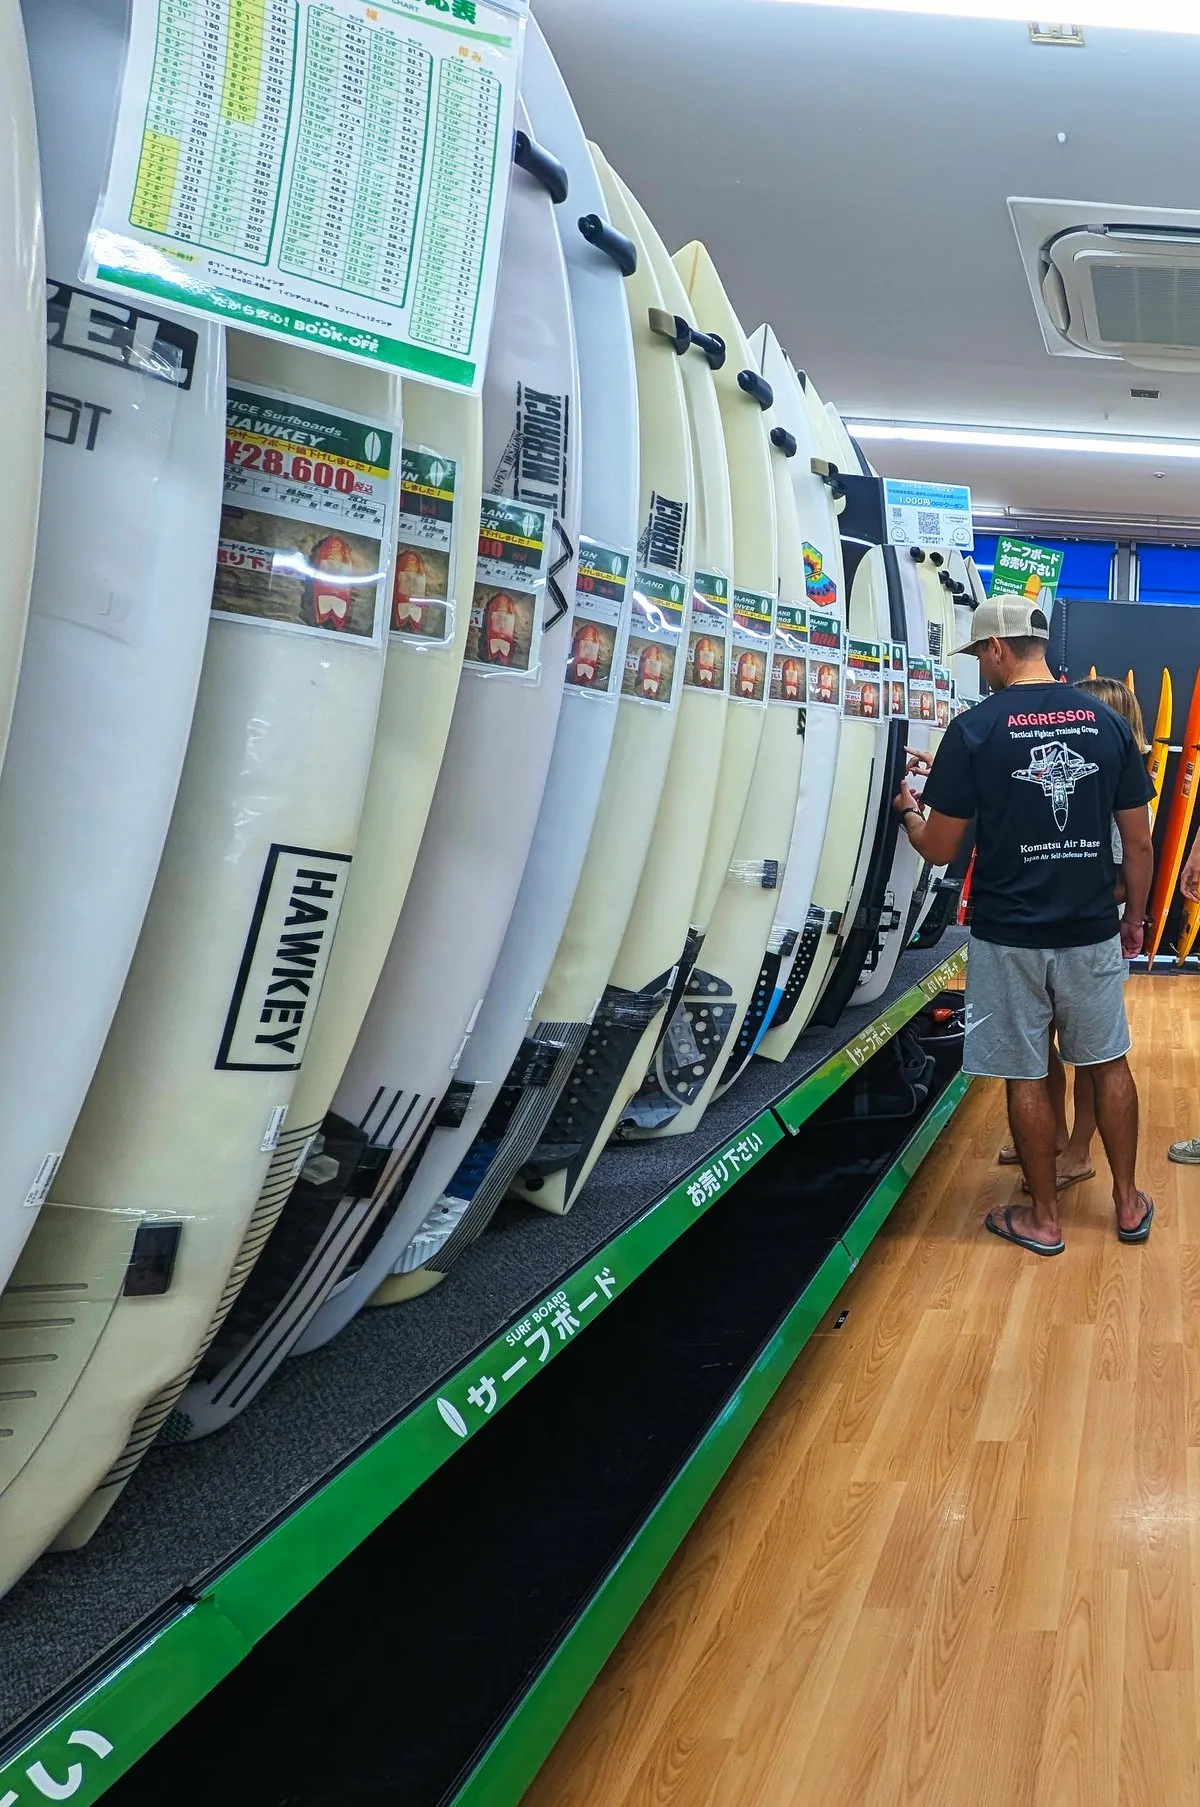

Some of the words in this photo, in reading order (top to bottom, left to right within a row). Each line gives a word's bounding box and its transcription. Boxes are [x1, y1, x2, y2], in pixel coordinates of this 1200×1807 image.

[206, 1, 221, 9] 175
[272, 5, 287, 14] 241
[205, 10, 220, 20] 178
[272, 15, 287, 24] 244
[204, 21, 220, 30] 180
[270, 36, 286, 45] 249
[202, 42, 218, 51] 185
[270, 46, 284, 55] 251
[201, 52, 217, 61] 188
[269, 56, 284, 65] 254
[201, 62, 215, 71] 191
[268, 66, 283, 75] 257
[196, 100, 211, 109] 201
[265, 96, 281, 105] 264
[194, 109, 210, 118] 203
[264, 105, 280, 114] 267
[191, 128, 207, 137] 208
[262, 124, 277, 132] 272
[189, 137, 205, 146] 211
[261, 133, 276, 142] 274
[259, 142, 274, 151] 277
[188, 147, 204, 156] 213
[258, 151, 273, 160] 279
[187, 156, 203, 165] 216
[185, 166, 202, 175] 218
[184, 175, 200, 184] 221
[254, 179, 269, 187] 287
[182, 185, 199, 193] 224
[252, 188, 268, 196] 290
[251, 197, 266, 205] 292
[179, 203, 195, 211] 229
[178, 212, 193, 220] 231
[248, 215, 263, 224] 297
[176, 221, 193, 230] 234
[247, 224, 262, 233] 300
[174, 230, 191, 239] 236
[245, 233, 261, 242] 302
[262, 409, 343, 438] Surfboards
[226, 415, 325, 447] HAWKEY
[522, 386, 562, 486] MERRICK
[650, 494, 683, 570] MERRICK
[1002, 541, 1060, 565] サーフボード
[1000, 554, 1055, 577] お売り下さい
[995, 579, 1022, 590] Channel
[1007, 710, 1096, 727] AGGRESSOR
[1010, 730, 1033, 739] Tactical
[1034, 728, 1055, 739] Fighter
[1055, 727, 1081, 735] Training
[1081, 725, 1099, 735] Group
[1020, 842, 1061, 853] Komatsu
[1064, 839, 1078, 848] Air
[1080, 839, 1100, 848] Base
[1024, 855, 1039, 863] Japan
[254, 868, 338, 1054] HAWKEY
[854, 1022, 891, 1061] サーフボード
[686, 1132, 763, 1207] お売り下さい
[505, 1319, 533, 1347] SURF
[532, 1290, 567, 1324] BOARD
[466, 1266, 616, 1414] サーフボード
